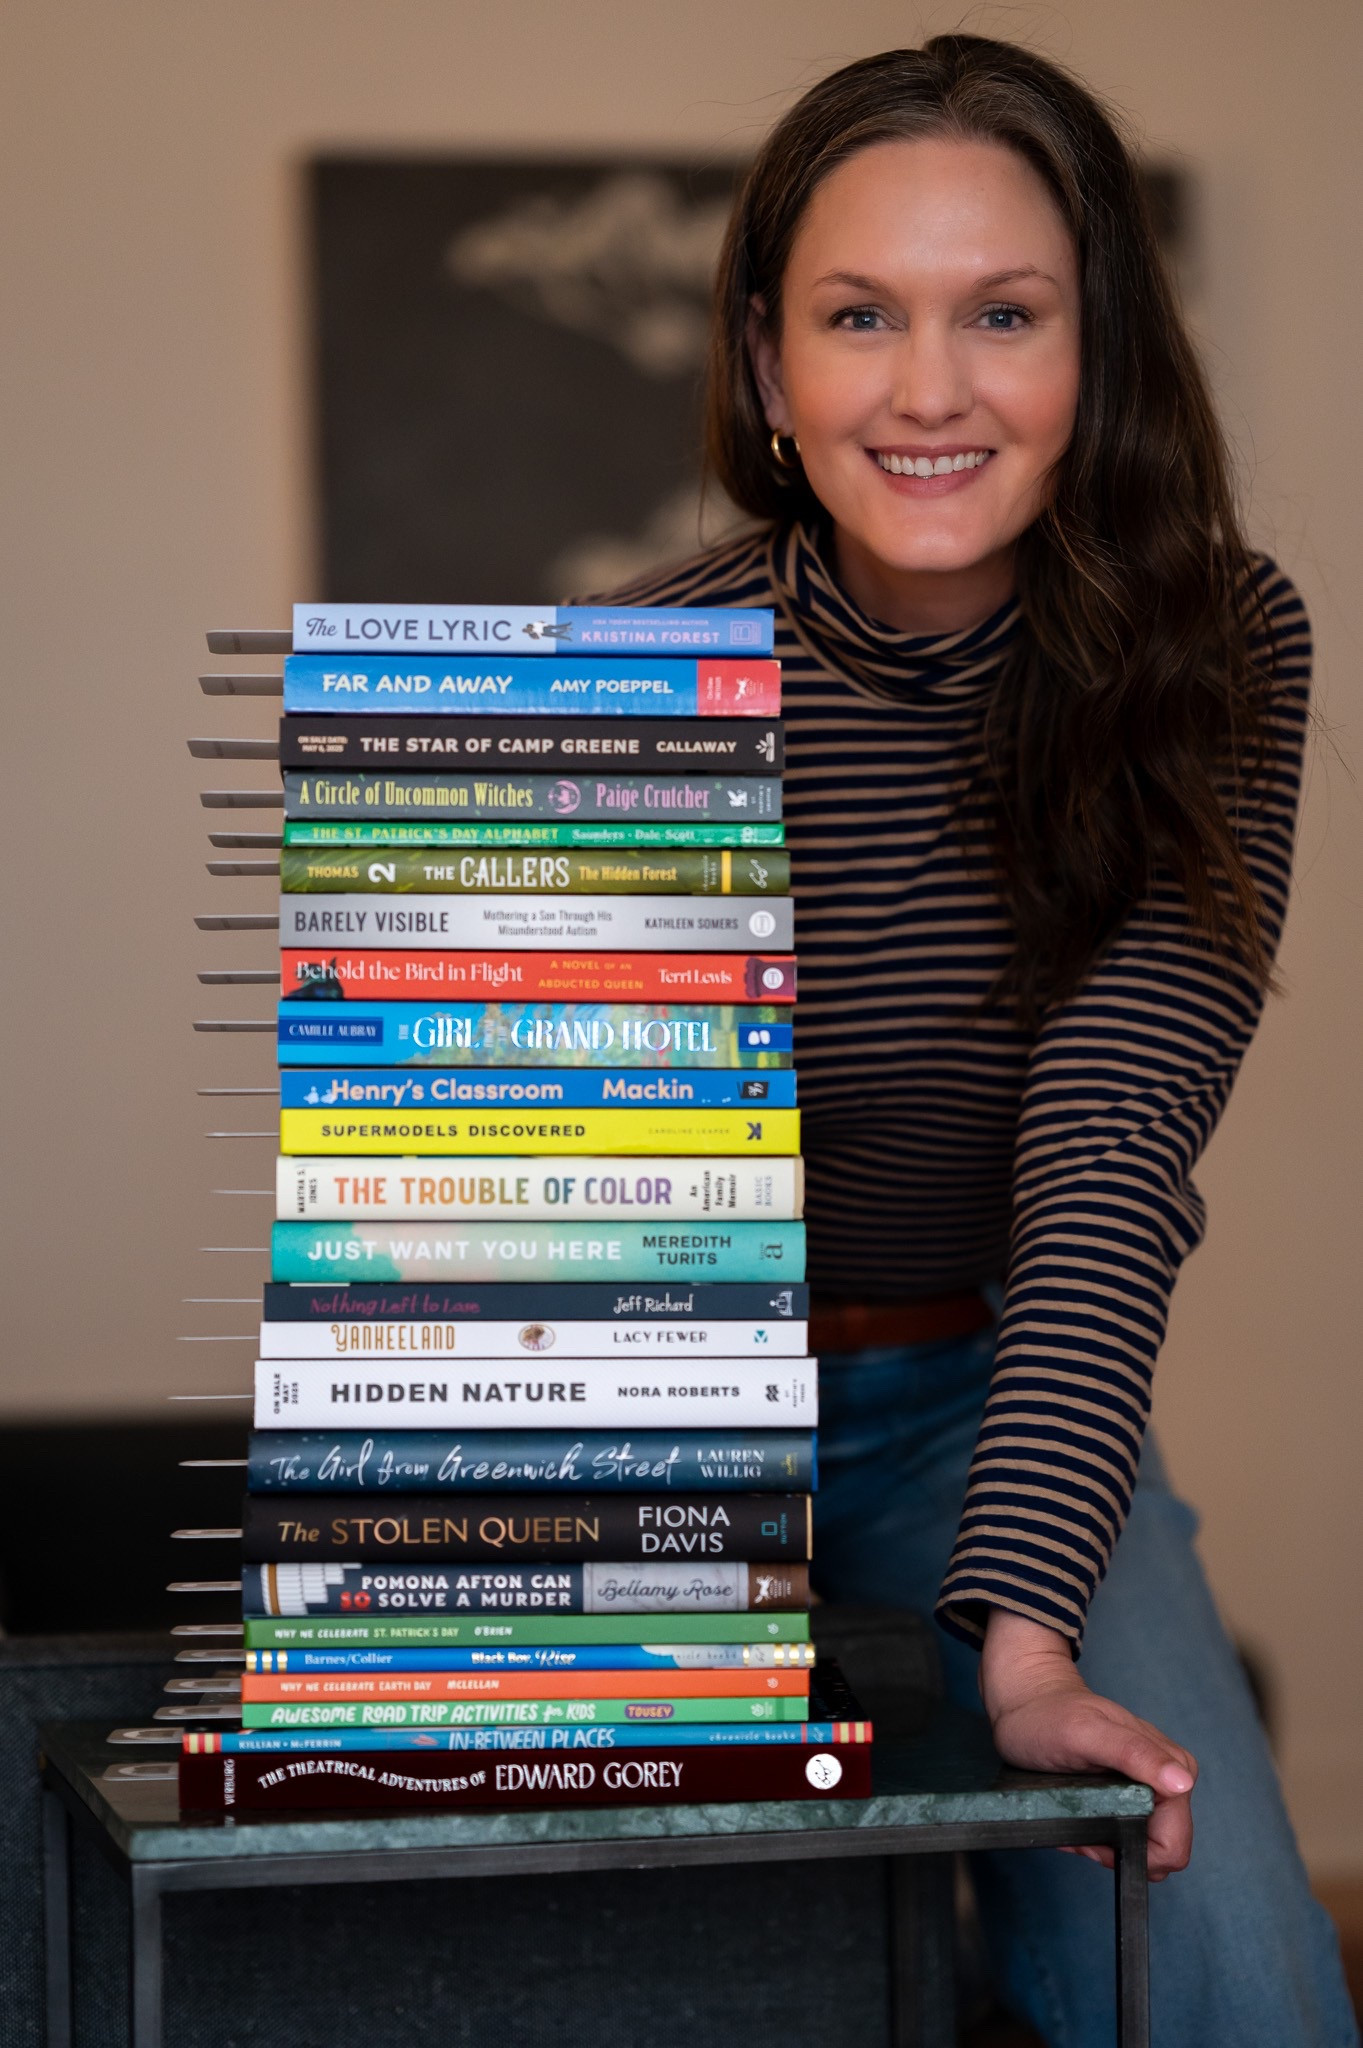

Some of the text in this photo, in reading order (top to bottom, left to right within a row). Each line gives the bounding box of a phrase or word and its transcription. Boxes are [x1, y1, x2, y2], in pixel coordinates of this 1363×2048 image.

[306, 617, 512, 641] The LOVE LYRIC
[581, 631, 720, 645] KRISTINA FOREST
[323, 674, 513, 694] FAR AND AWAY
[550, 679, 674, 694] AMY POEPPEL
[360, 737, 640, 754] THE STAR OF CAMP GREENE
[656, 741, 737, 753] CALLAWAY
[300, 780, 534, 808] A Circle of Uncommon Witches
[596, 783, 710, 812] Paige Crutcher
[312, 827, 559, 840] THE PATRICK'S DAY ALPHABET
[572, 828, 625, 841] Saunders
[307, 866, 359, 879] THOMAS
[368, 862, 397, 883] 2
[423, 856, 570, 888] THE CALLERS
[579, 865, 677, 881] The Hidden Forest
[294, 911, 449, 933] BARELY VISIBLE
[483, 910, 612, 922] Mothering Son Through His
[644, 918, 739, 930] KATHLEEN SOMERS
[498, 924, 597, 936] Misunderstood Autism
[296, 960, 523, 988] Behold the Bird in Flight
[550, 960, 600, 970] A NOVEL
[538, 979, 644, 990] ABDUCTED QUEEN
[658, 968, 733, 984] Terri Lewis
[288, 1023, 377, 1038] CAMILLE AUBRAY
[413, 1016, 480, 1049] GIRL
[511, 1018, 615, 1050] GRAND
[622, 1020, 718, 1052] HOTEL
[331, 1077, 564, 1107] Henry's Classroom
[601, 1077, 695, 1100] Mackin
[322, 1125, 587, 1137] SUPERMODELS DISCOVERED
[334, 1177, 672, 1205] THE TROUBLE OF COLOR
[702, 1170, 711, 1212] American
[714, 1176, 725, 1206] Family
[728, 1173, 736, 1208] Memoir
[764, 1175, 773, 1206] BOOKS
[307, 1240, 622, 1261] JUST WANT YOU HERE
[643, 1235, 731, 1248] MEREDITH
[657, 1252, 717, 1265] TURITS
[310, 1292, 481, 1316] Nothing Left to Lose
[613, 1292, 694, 1314] Jeff Richard
[331, 1324, 456, 1352] YANKEELAND
[613, 1331, 708, 1343] LACY FEWER
[331, 1383, 586, 1403] HIDDEN NATURE
[618, 1386, 741, 1397] NORA ROBERTS
[270, 1438, 682, 1486] The Girl from Greenwich Street
[697, 1449, 765, 1463] LAUREN
[700, 1465, 762, 1478] WILLIG
[638, 1505, 731, 1528] FIONA
[278, 1516, 600, 1548] The STOLEN QUEEN
[641, 1532, 724, 1553] DAVIS
[361, 1574, 572, 1590] POMONA AFTON CAN
[598, 1578, 734, 1601] Bellamy Rose
[340, 1591, 572, 1609] SO SOLVE A MURDER
[275, 1627, 459, 1639] WHY CELEBRATE PATRICK'S DAY
[474, 1626, 513, 1636] O'BRIEN
[304, 1653, 393, 1666] Barnes/Collier
[535, 1649, 576, 1667] Rise
[280, 1681, 432, 1692] WHY WE CELEBRATE EARTH DAY
[271, 1703, 596, 1724] AWESOME ROAD TRIP ACTIVITIES for KIDS
[628, 1706, 672, 1718] TOUSEY
[239, 1738, 342, 1750] KILLIAN McFERRIN
[448, 1727, 616, 1751] IN-BETWEEN PLACES
[709, 1730, 796, 1742] chronicle books
[224, 1758, 236, 1806] VERBURG
[258, 1760, 487, 1792] THE THEATRICAL ADVENTURES OF
[495, 1760, 683, 1790] EDWARD GOREY
